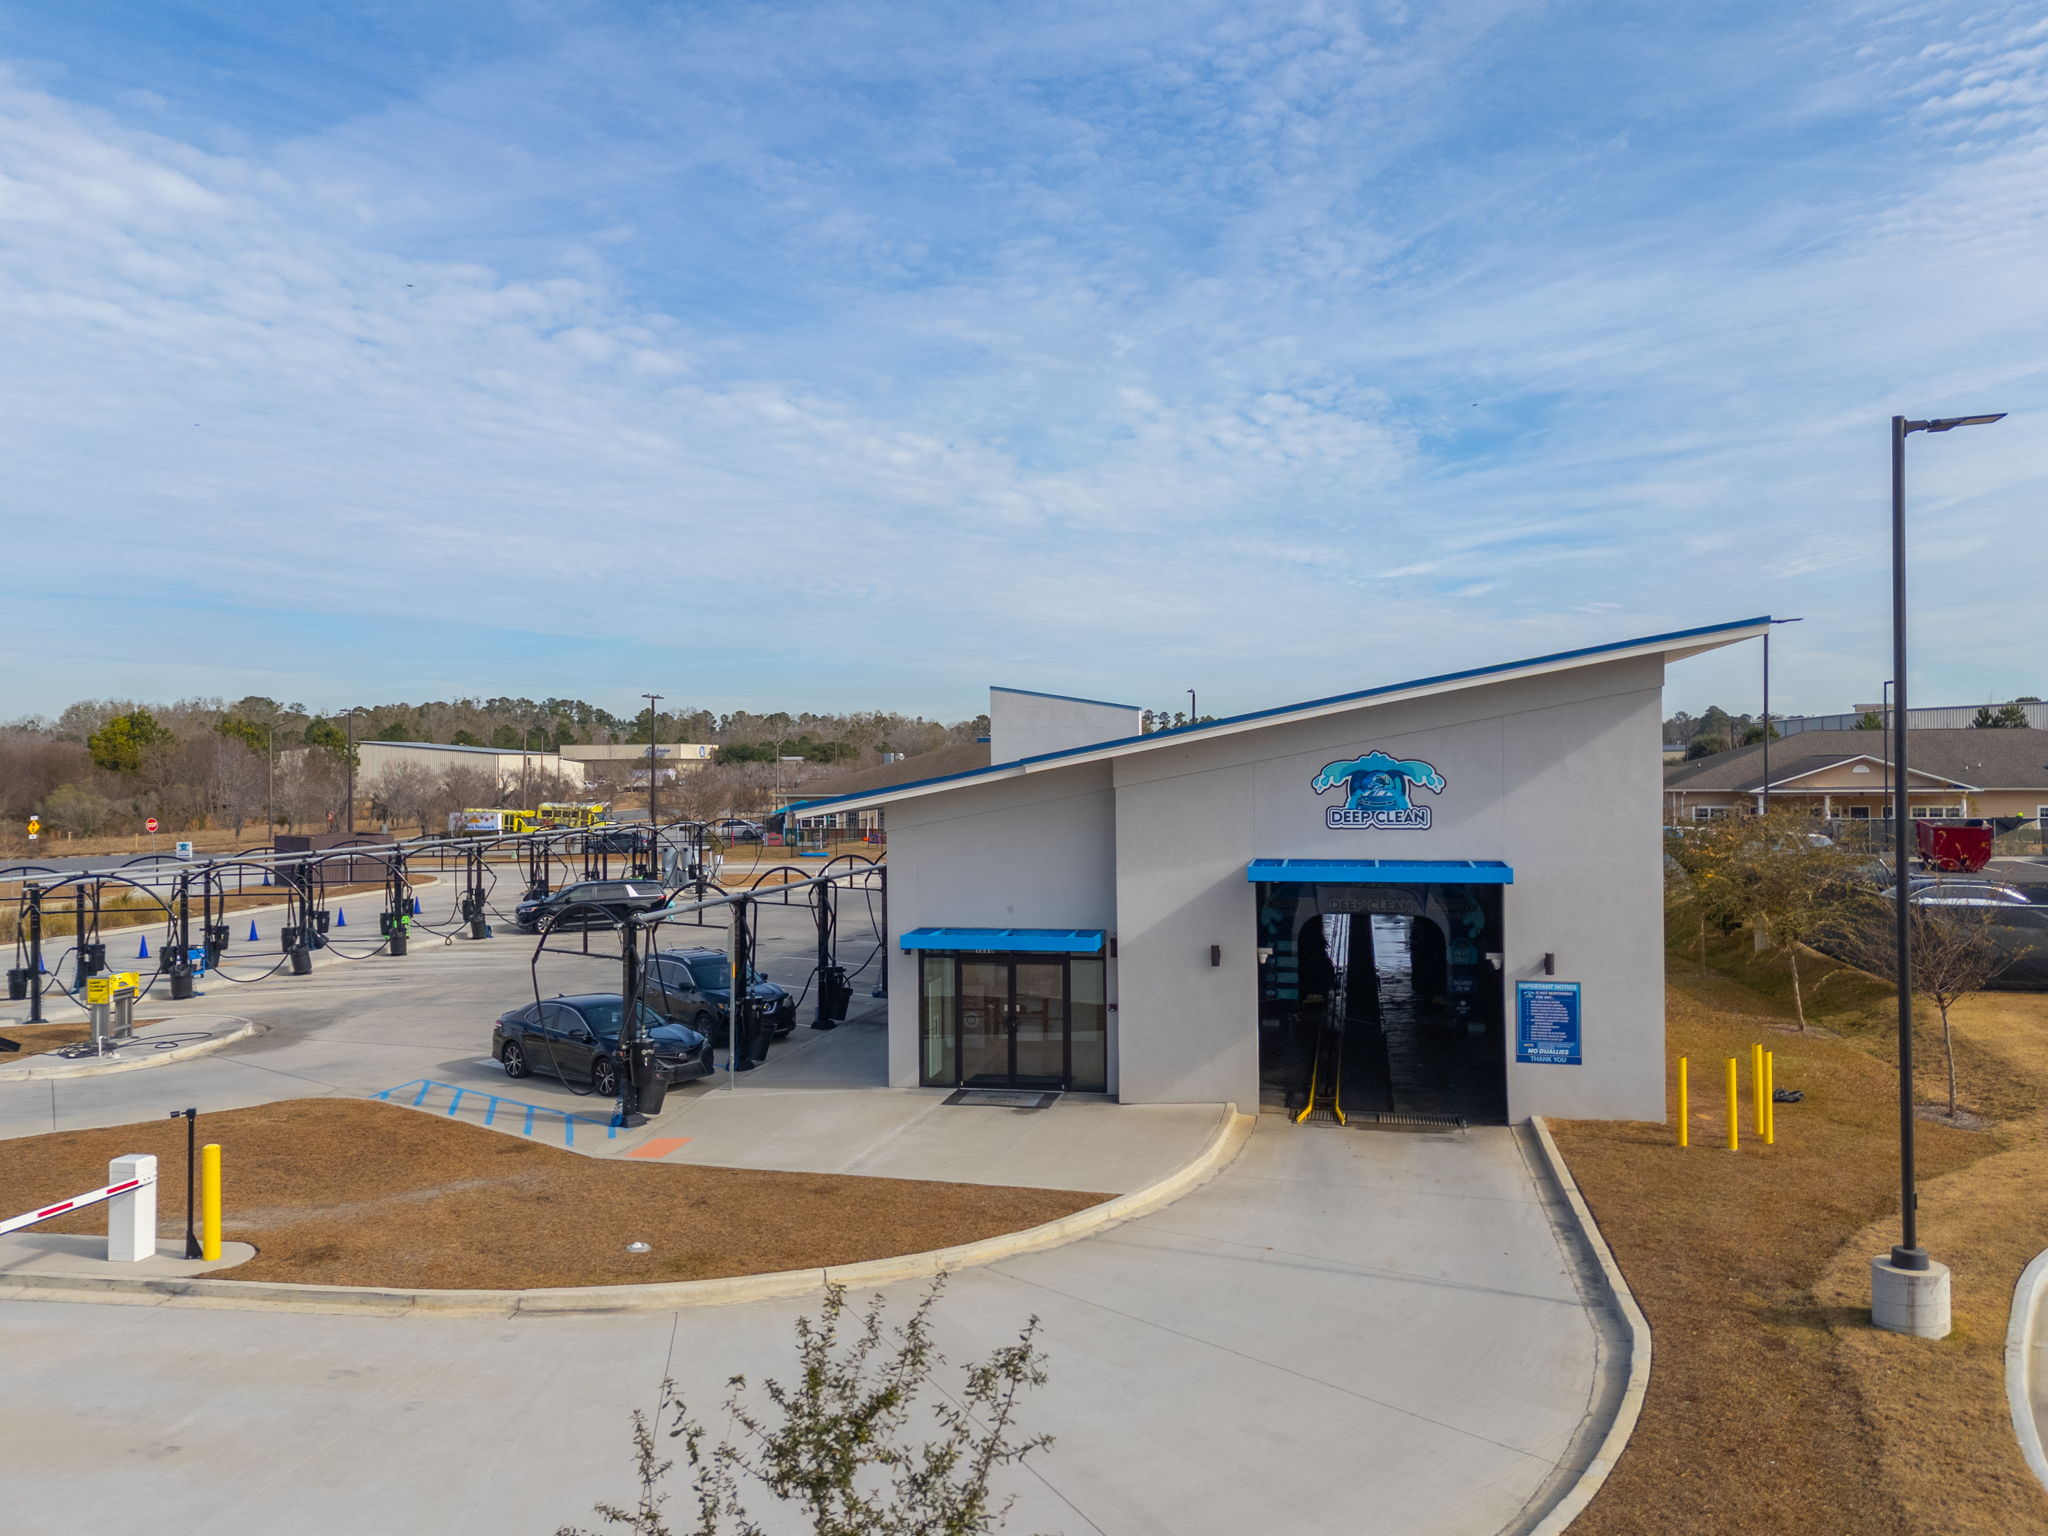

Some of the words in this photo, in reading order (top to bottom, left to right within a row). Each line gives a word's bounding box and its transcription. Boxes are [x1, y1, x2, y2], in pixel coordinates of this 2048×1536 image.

[1331, 810, 1371, 823] DEEP
[1375, 810, 1426, 824] CLEAN
[1330, 899, 1364, 911] DEEP
[1368, 899, 1413, 912] CLEAN
